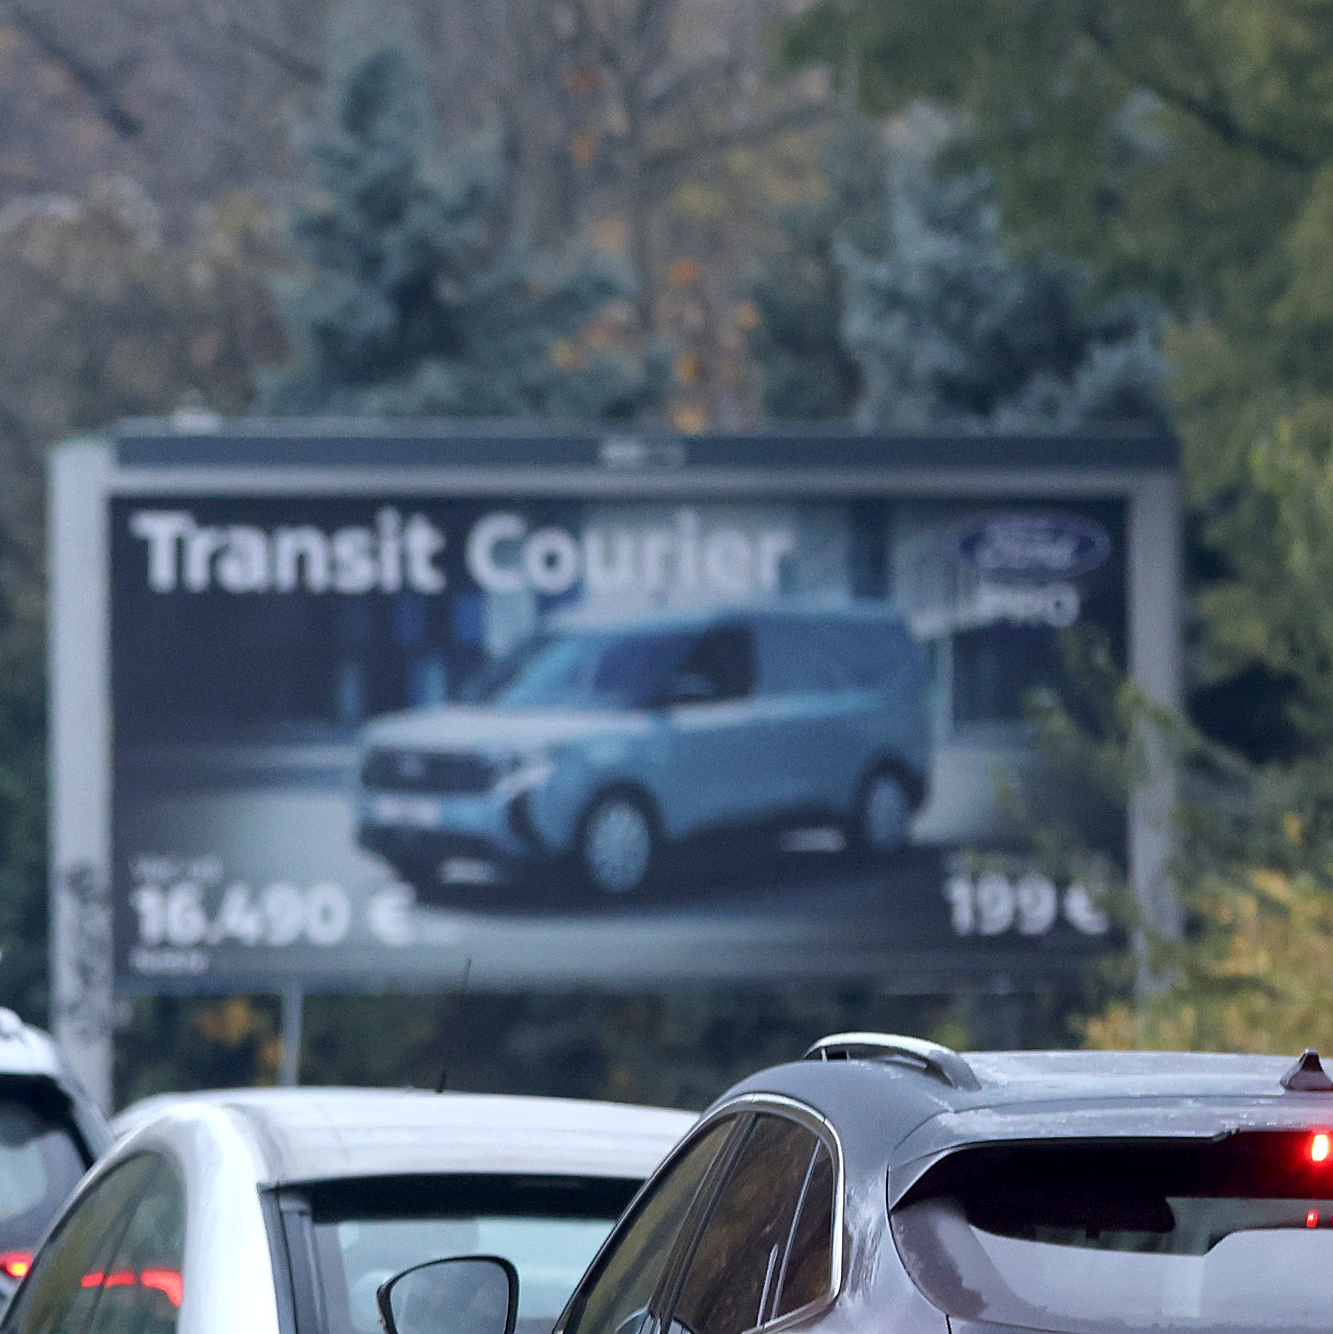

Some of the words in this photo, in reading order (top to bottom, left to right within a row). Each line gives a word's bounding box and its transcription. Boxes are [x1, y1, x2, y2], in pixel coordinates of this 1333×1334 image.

[131, 507, 445, 592] Transit
[464, 508, 797, 595] Courier
[132, 881, 349, 946] 16.490
[371, 881, 418, 947] €
[943, 874, 1057, 936] 199
